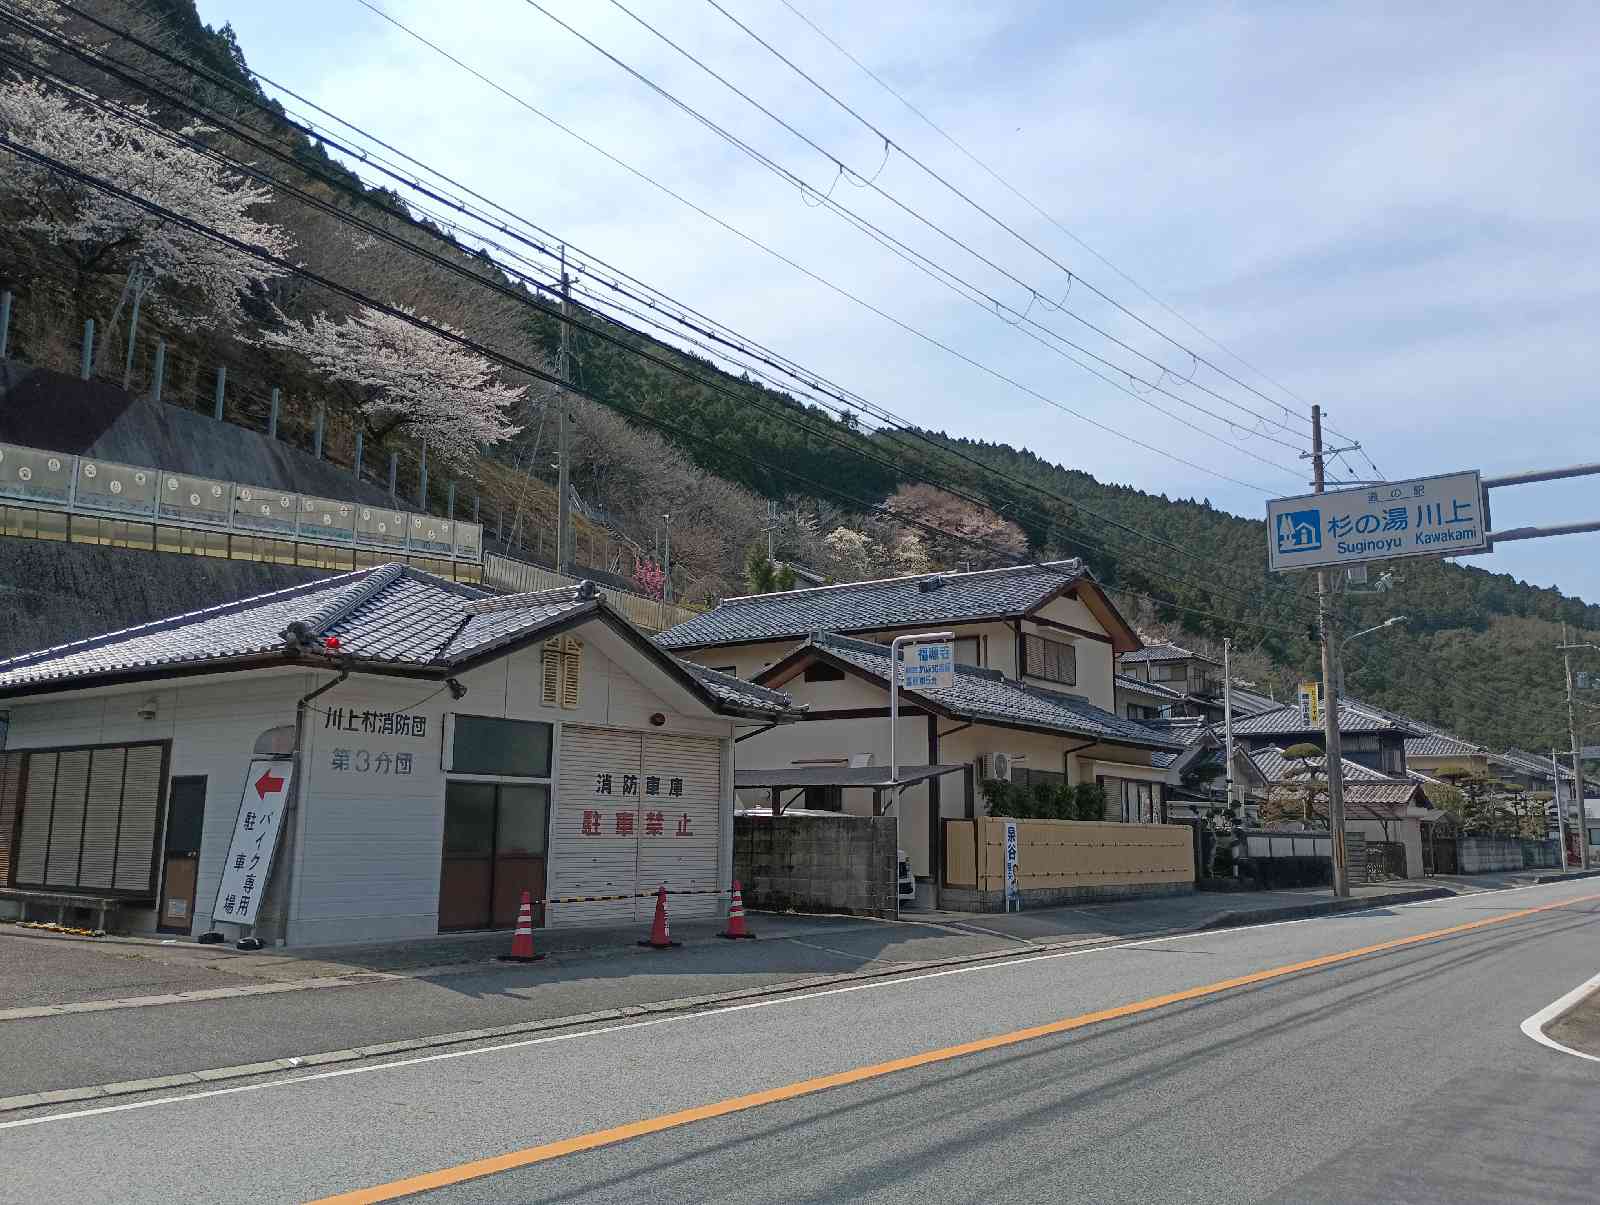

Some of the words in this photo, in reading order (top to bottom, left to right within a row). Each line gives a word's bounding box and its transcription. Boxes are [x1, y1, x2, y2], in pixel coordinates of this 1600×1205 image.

[1337, 538, 1402, 555] Suginoyu
[1415, 526, 1477, 545] Kawakami
[324, 706, 427, 738] 川上村消防団
[331, 747, 414, 775] 第3分団
[596, 773, 683, 797] 消防車庫
[581, 810, 694, 837] 駐車禁止
[223, 811, 257, 915] 駐車場
[237, 811, 275, 917] バイク専用
